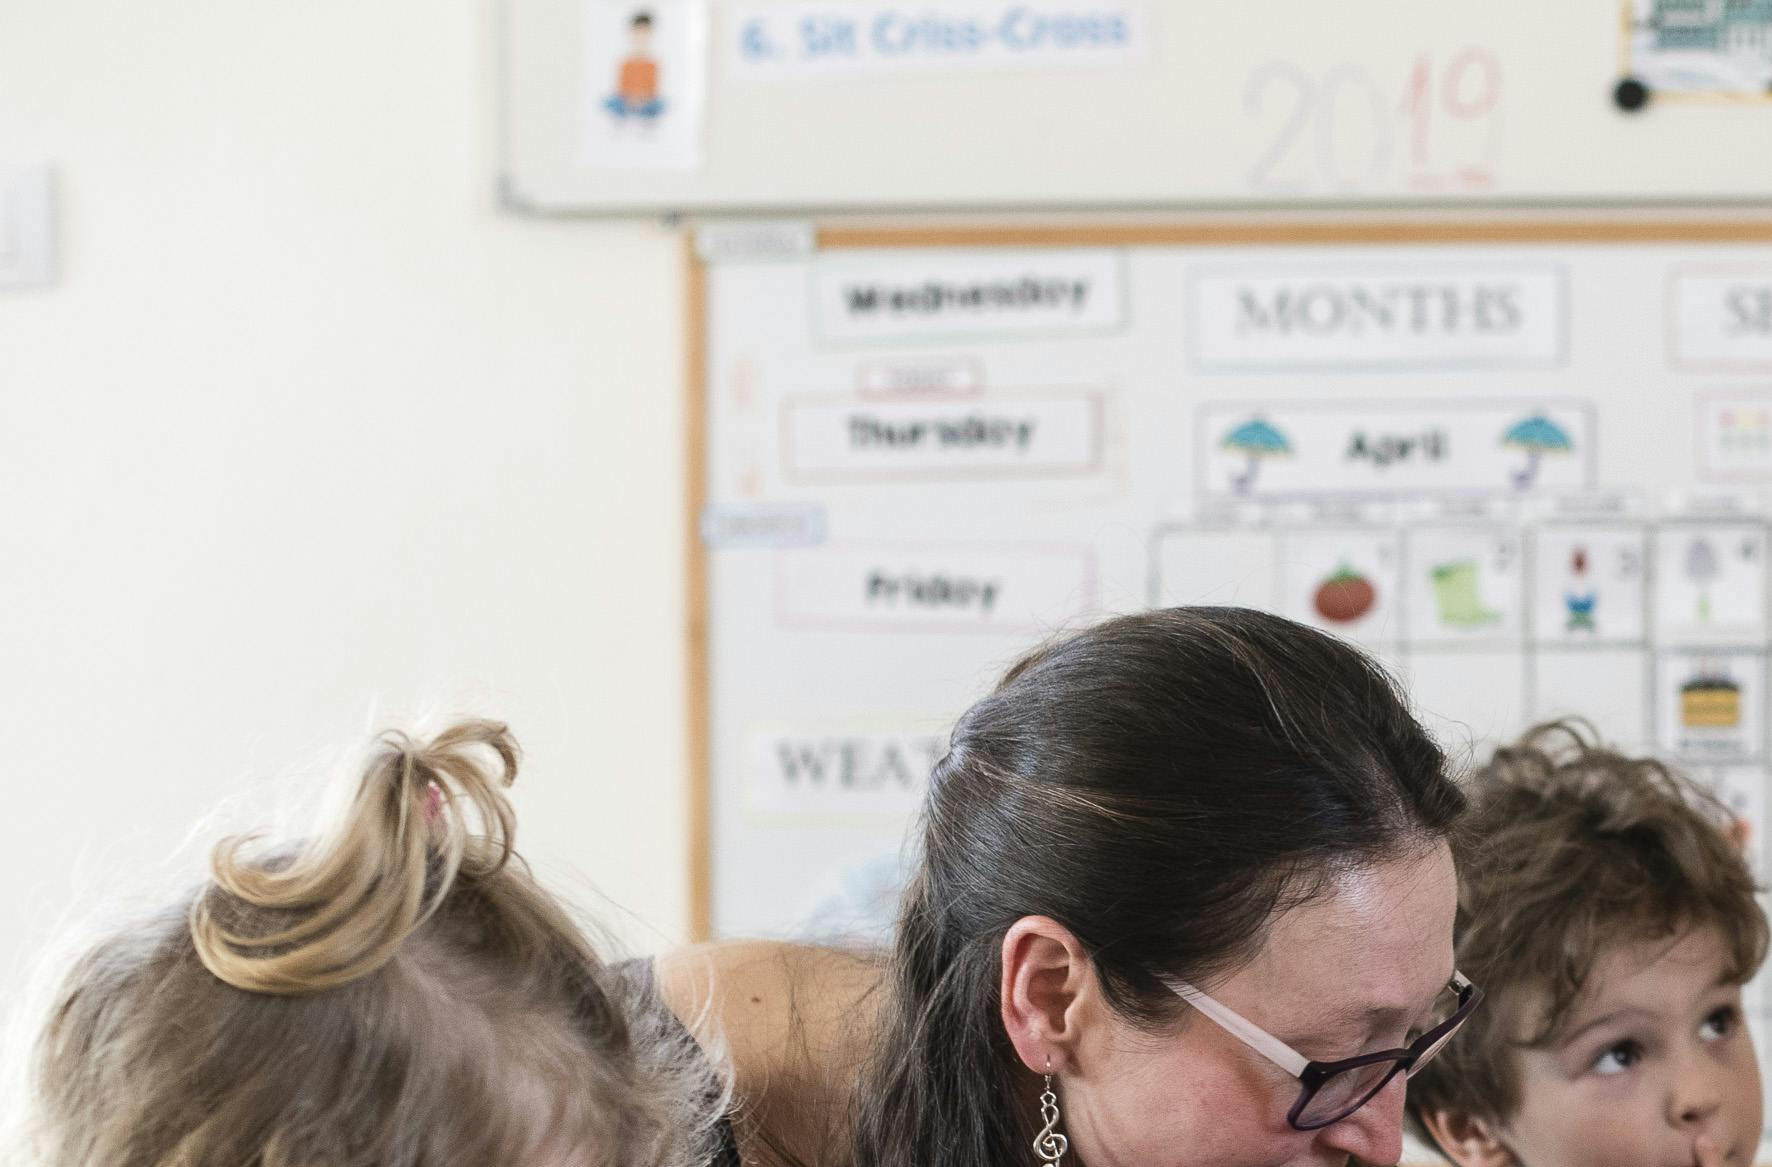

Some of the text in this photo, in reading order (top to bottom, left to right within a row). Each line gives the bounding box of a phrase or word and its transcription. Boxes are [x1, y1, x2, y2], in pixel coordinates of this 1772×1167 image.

[799, 15, 858, 57] Sit
[871, 8, 1130, 54] Criss-Cross
[1243, 47, 1504, 192] 2019
[845, 274, 1089, 315] Wednesday
[1236, 282, 1521, 338] MONTHS
[848, 411, 1034, 454] Thursday
[1345, 427, 1446, 470] April
[865, 569, 999, 612] Friday
